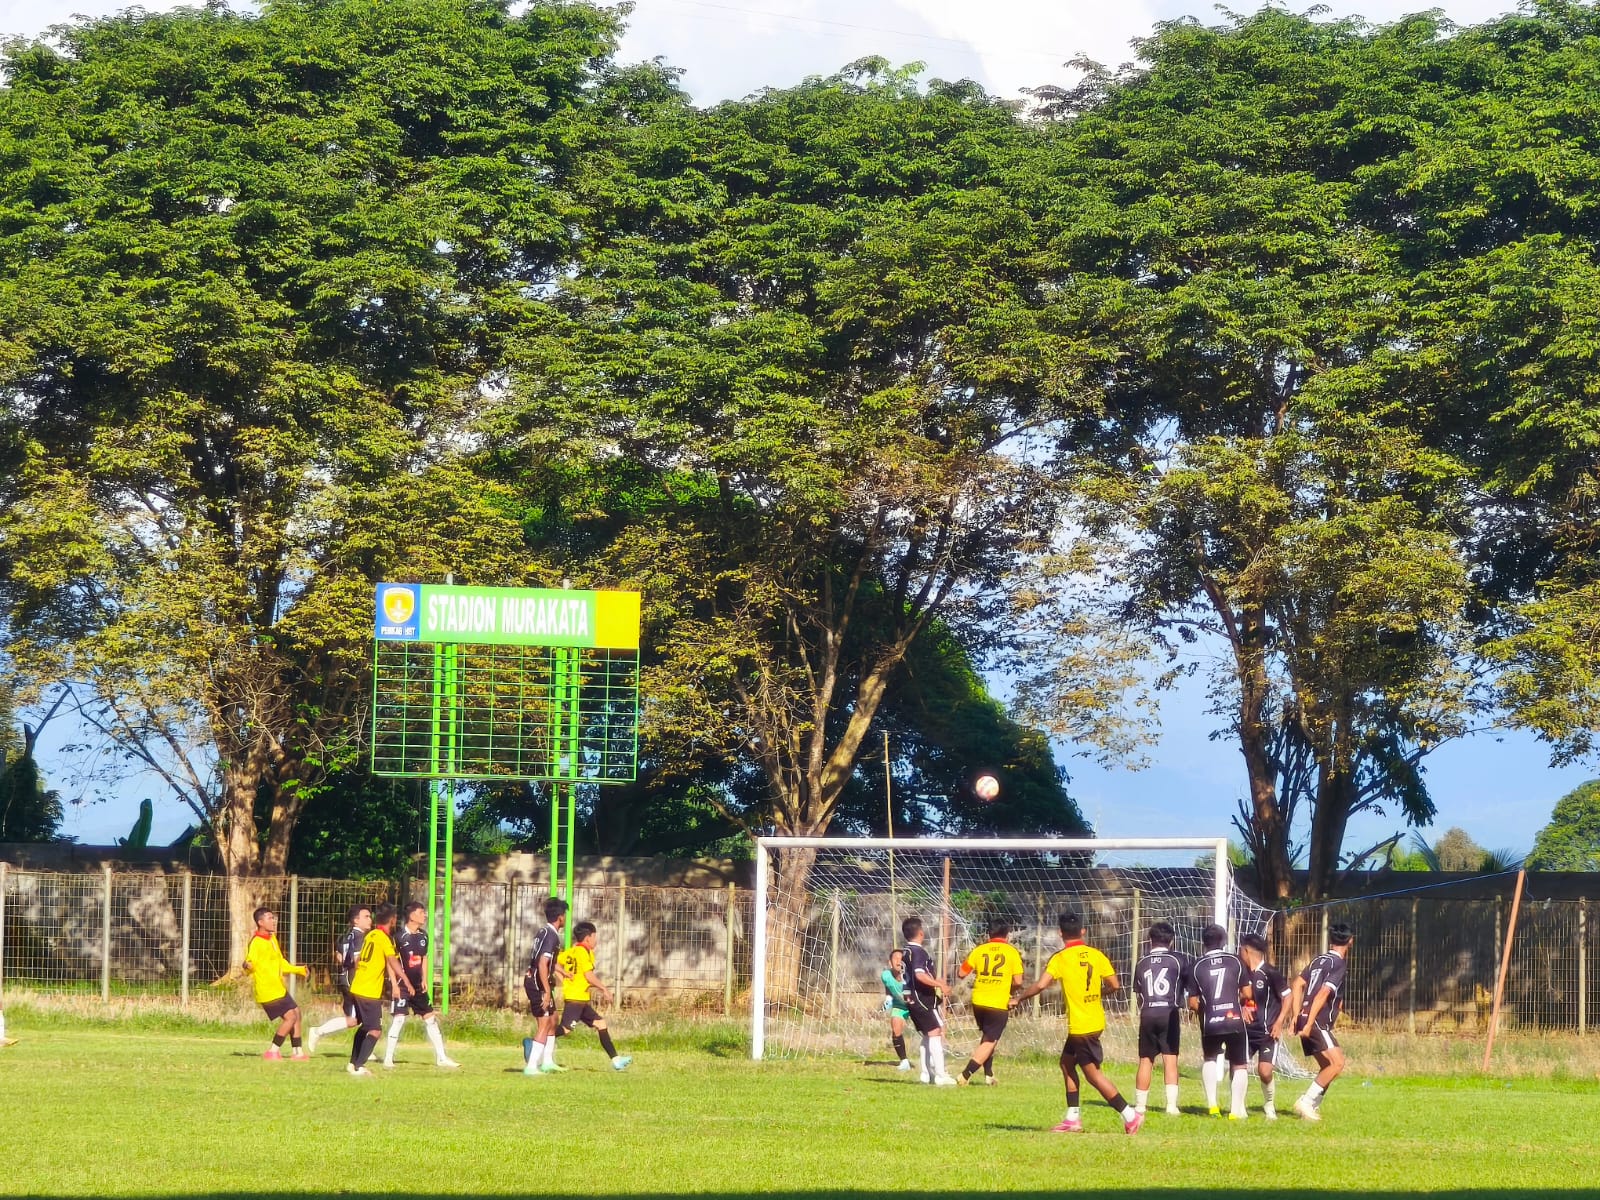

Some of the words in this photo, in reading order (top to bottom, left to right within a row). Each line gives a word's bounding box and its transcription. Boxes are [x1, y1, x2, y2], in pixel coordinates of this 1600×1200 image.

[428, 594, 496, 633] STADION
[502, 597, 588, 637] MURAKATA
[980, 953, 1006, 977] 12
[1080, 961, 1094, 991] 7
[1143, 967, 1170, 997] 16
[1209, 968, 1226, 999] 7
